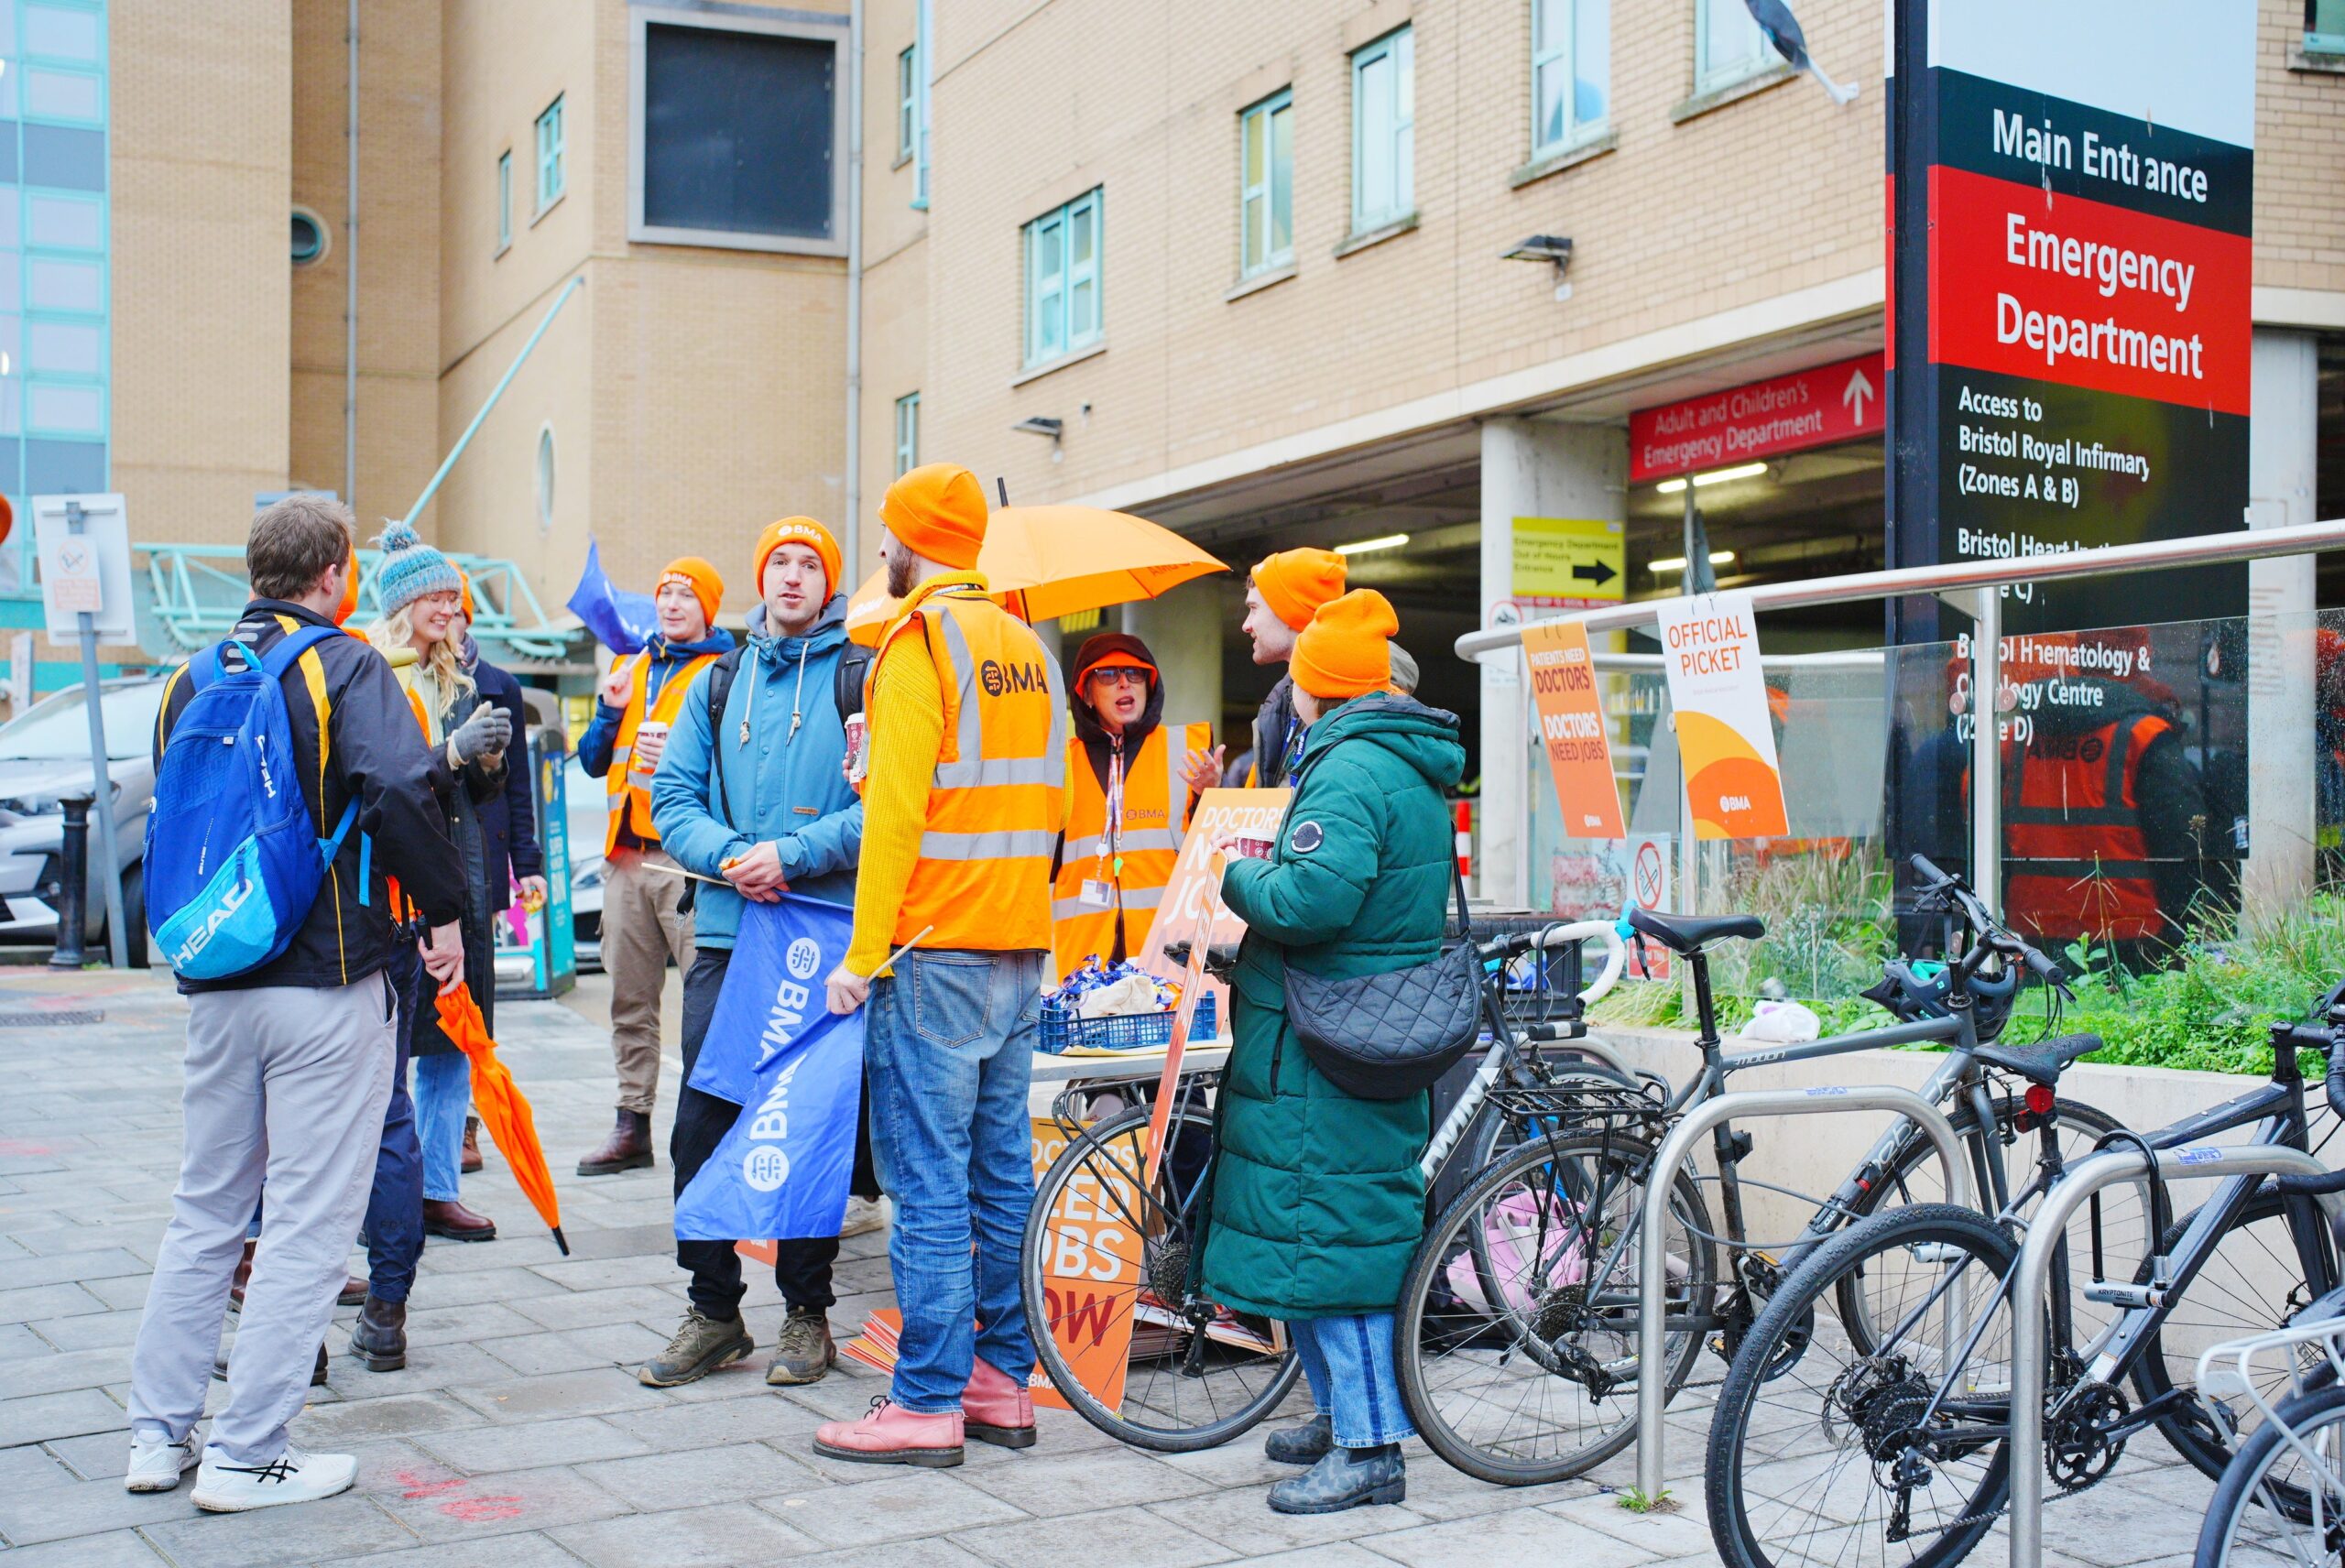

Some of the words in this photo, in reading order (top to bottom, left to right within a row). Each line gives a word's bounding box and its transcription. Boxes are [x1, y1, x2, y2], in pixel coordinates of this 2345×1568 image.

[1992, 108, 2071, 170] Main
[2083, 130, 2208, 203] Entrance
[2006, 212, 2195, 313] Emergency
[1997, 292, 2203, 380] Department
[1654, 408, 1696, 436] Adult
[1697, 400, 1728, 427] and
[1730, 380, 1808, 419] Children's
[1958, 385, 2019, 419] Access
[2023, 397, 2043, 422] to
[1643, 434, 1723, 469] Emergency
[1726, 409, 1823, 453] Department
[1958, 424, 2017, 458] Bristol
[2022, 433, 2071, 470] Royal
[2075, 441, 2150, 483] Infirmary
[1958, 463, 2020, 497] (Zones
[2023, 473, 2039, 500] A
[2043, 474, 2057, 503] &
[2061, 476, 2079, 508] B)
[793, 523, 823, 542] BMA
[1958, 527, 2016, 558] Bristol
[1668, 615, 1749, 649] OFFICIAL
[1529, 649, 1564, 667] PATIENTS
[1563, 648, 1586, 664] NEED
[1680, 646, 1741, 677] PICKET
[2138, 646, 2151, 672] &
[1534, 665, 1590, 694] DOCTORS
[2047, 679, 2103, 707] Centre
[1543, 712, 1600, 740] DOCTORS
[2014, 715, 2034, 747] D)
[1550, 742, 1580, 762] NEED
[1580, 740, 1605, 764] JOBS
[1138, 809, 1165, 820] BMA
[1729, 796, 1751, 811] BMA
[171, 878, 255, 970] HEAD
[2098, 1289, 2133, 1298] KRYPTONITE
